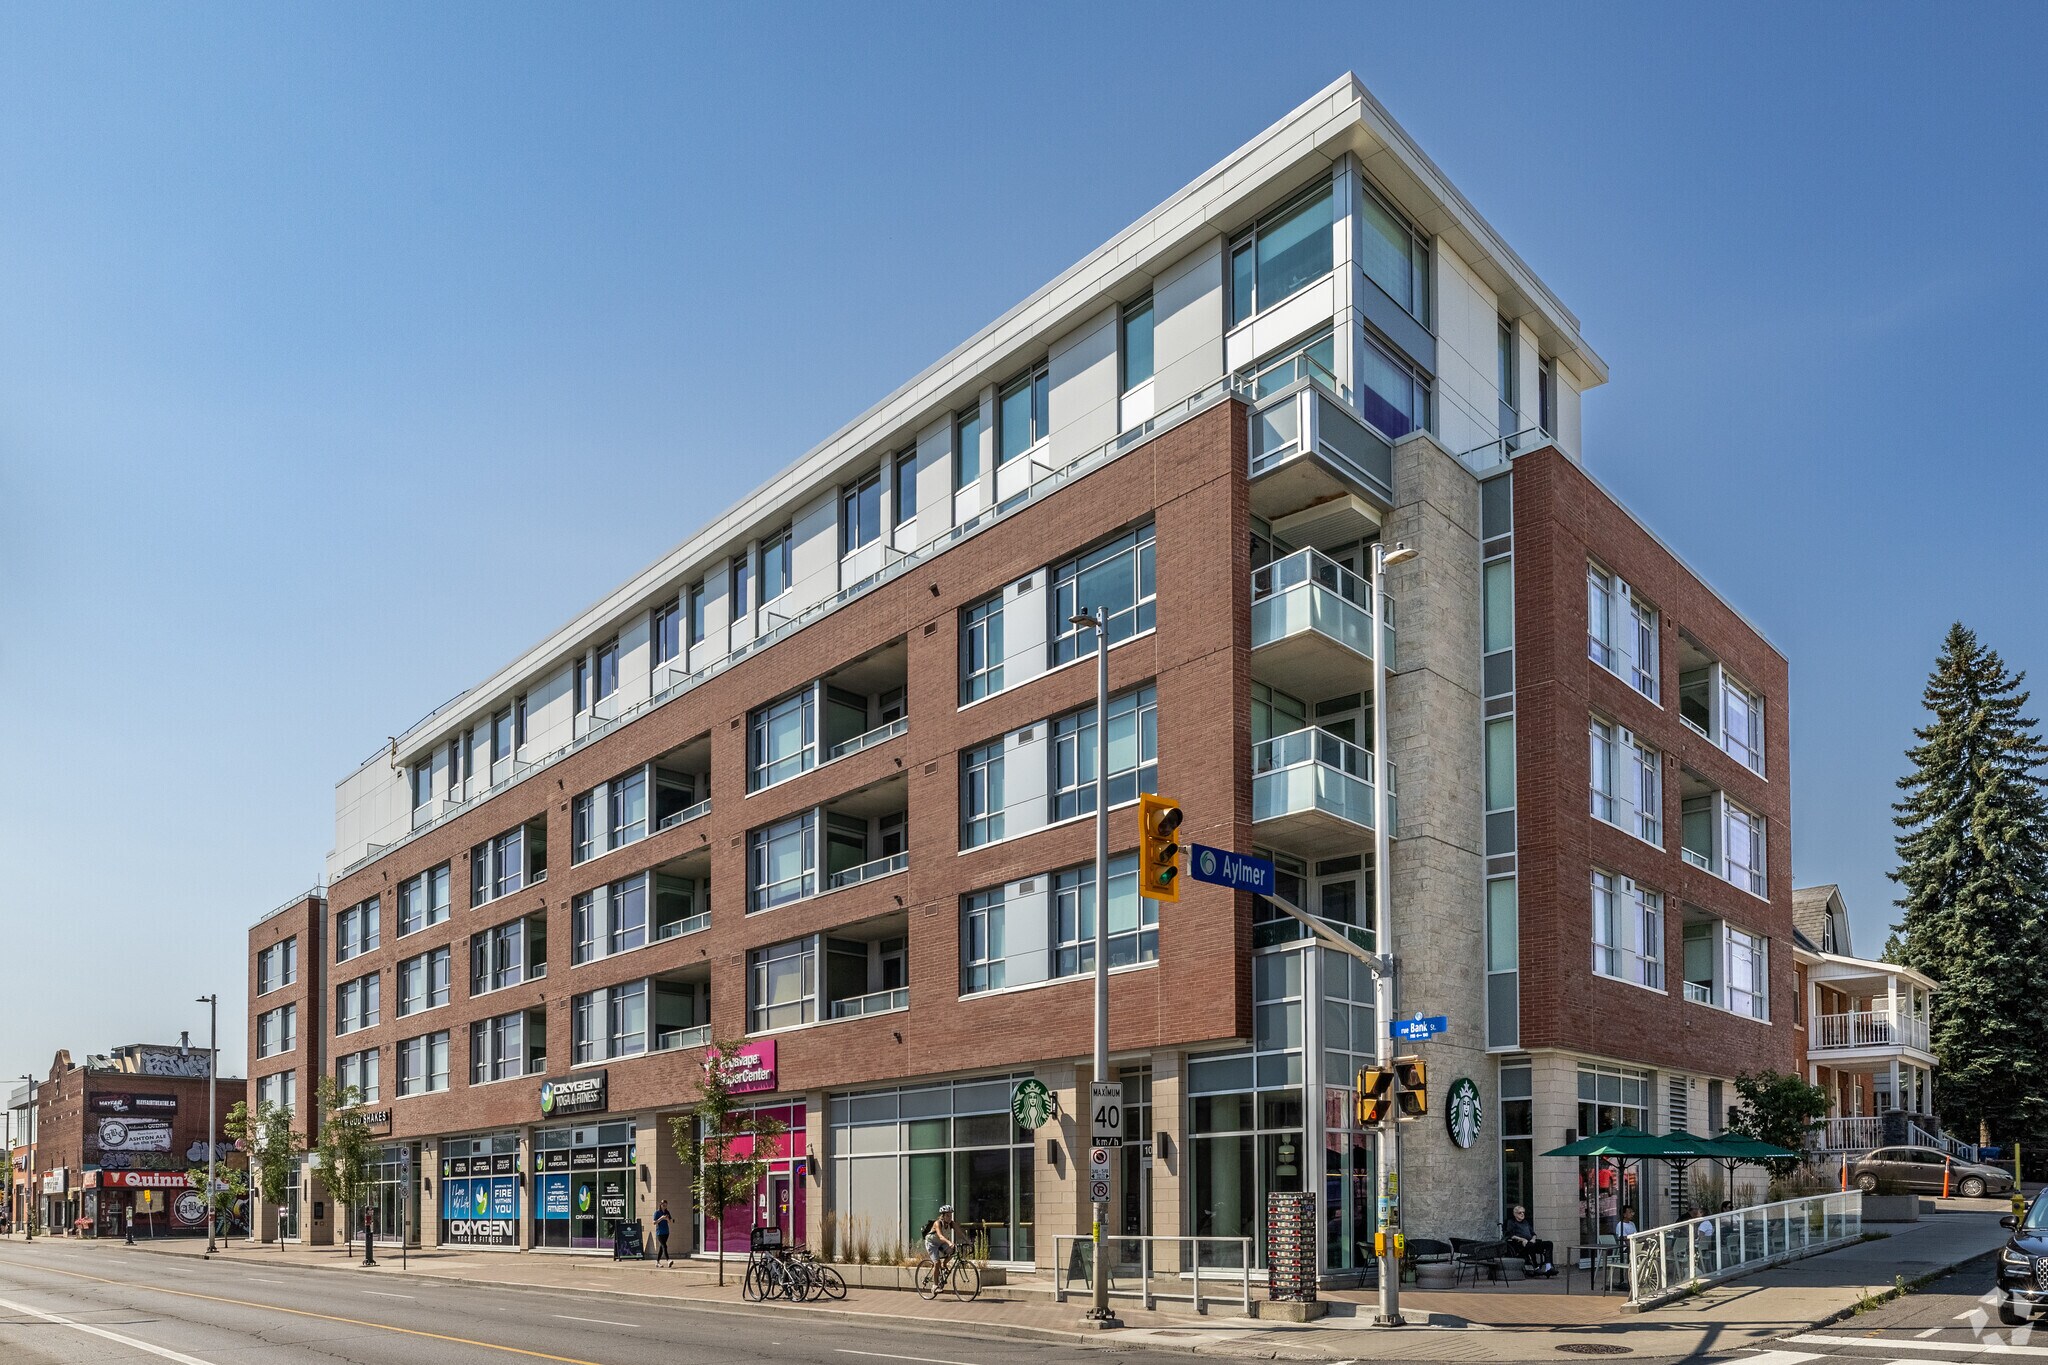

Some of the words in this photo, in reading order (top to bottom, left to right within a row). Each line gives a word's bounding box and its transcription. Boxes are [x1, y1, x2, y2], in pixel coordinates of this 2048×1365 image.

[1222, 855, 1266, 886] Aylmer
[1410, 1021, 1428, 1033] Bank
[554, 1078, 600, 1094] OXYGEN
[556, 1095, 570, 1106] YOGA
[571, 1094, 576, 1104] &
[576, 1090, 599, 1104] FITNESS
[1094, 1088, 1120, 1097] MAXIMUM
[362, 1111, 386, 1123] SHAKES
[1095, 1105, 1119, 1128] 40
[1096, 1138, 1119, 1146] km/h
[125, 1172, 195, 1187] Quinn's
[495, 1189, 512, 1198] FIRE
[495, 1205, 512, 1213] YOU
[601, 1199, 624, 1207] OXYGEN
[451, 1220, 512, 1236] OXYGEN
